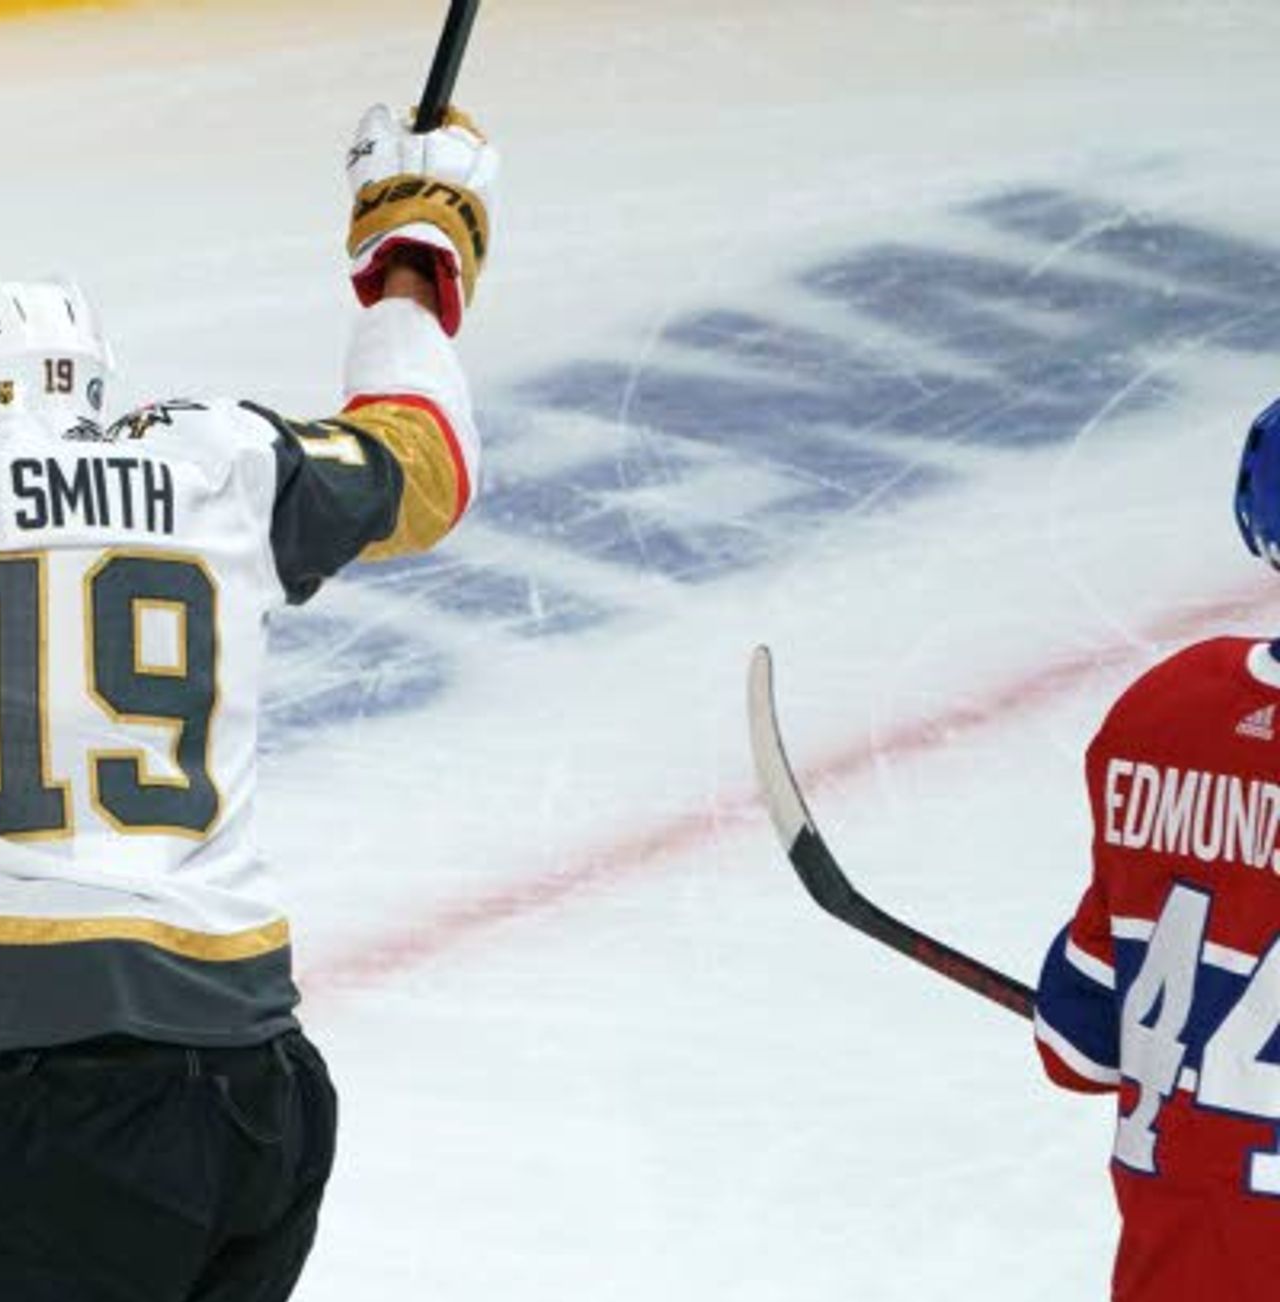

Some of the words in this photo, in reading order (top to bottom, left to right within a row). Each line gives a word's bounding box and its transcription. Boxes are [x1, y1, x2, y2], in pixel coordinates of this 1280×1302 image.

[44, 358, 74, 394] 19
[9, 457, 174, 535] SMITH
[1103, 758, 1280, 880] EDMUND
